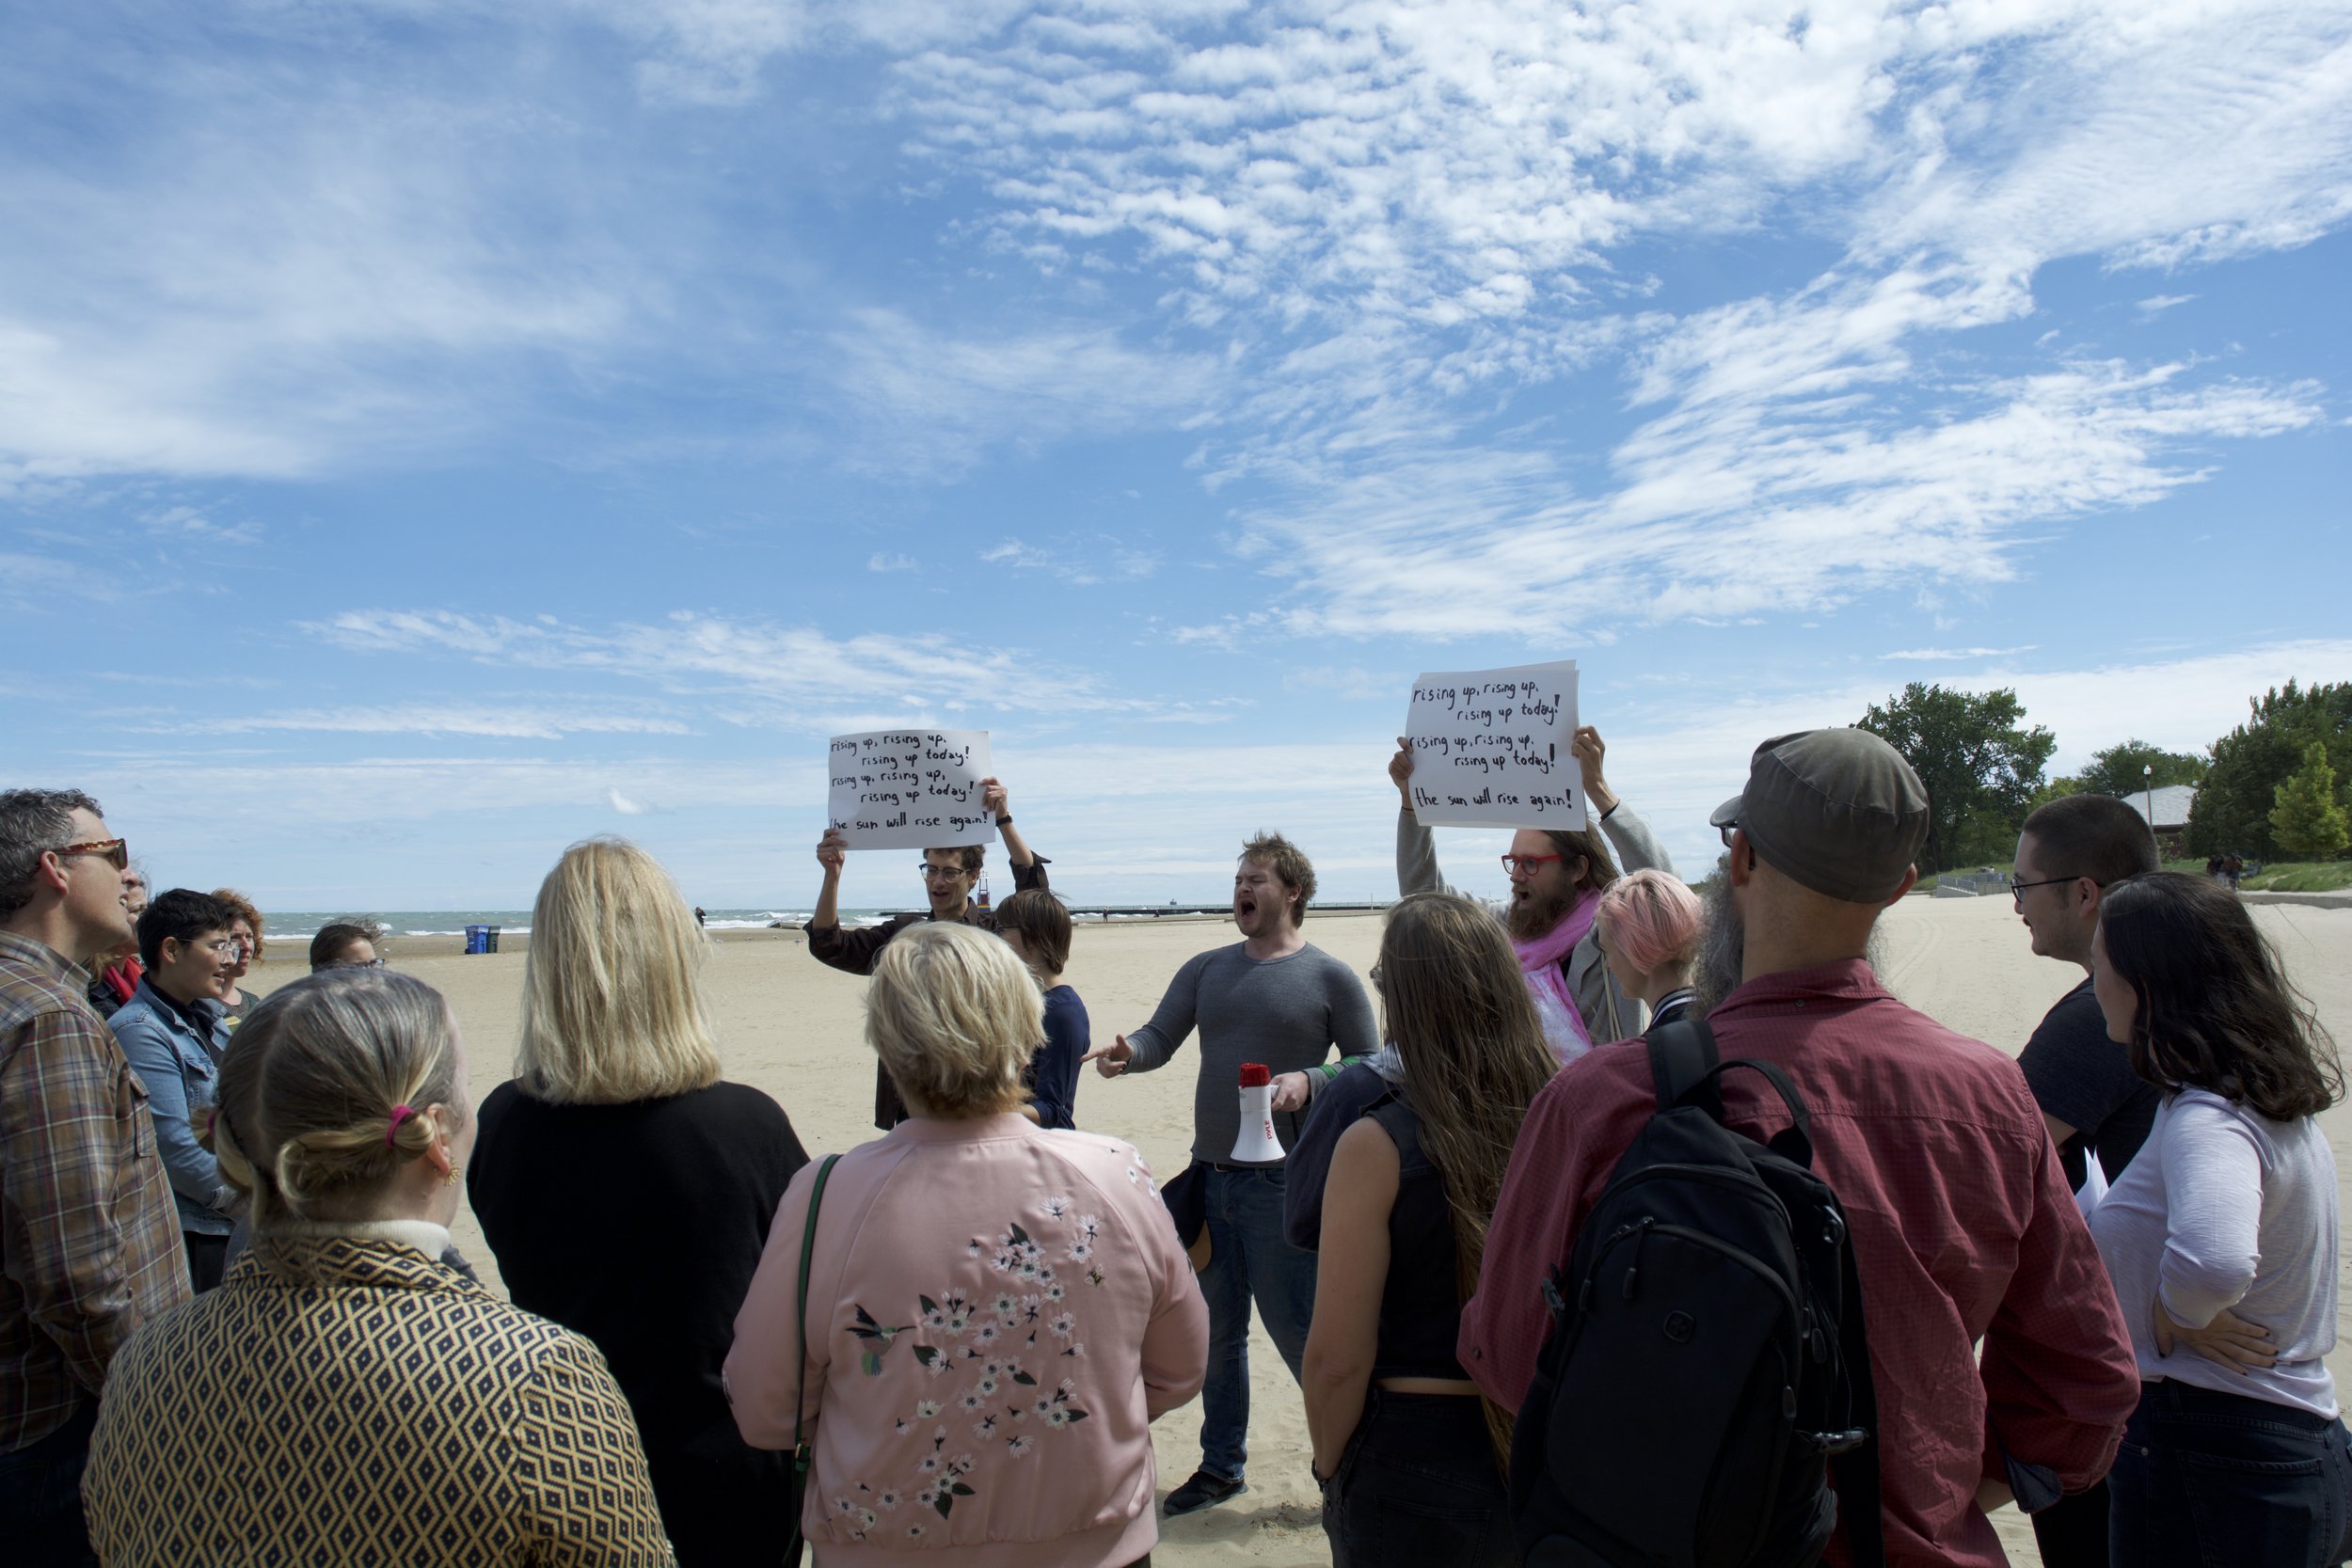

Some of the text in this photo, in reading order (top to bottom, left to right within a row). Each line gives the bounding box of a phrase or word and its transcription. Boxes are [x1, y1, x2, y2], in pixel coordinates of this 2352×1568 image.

[1412, 688, 1455, 710] rising
[1484, 683, 1516, 699] rising
[1457, 694, 1560, 727] rising up today!
[831, 740, 857, 756] rising
[883, 735, 920, 748] rising
[1409, 736, 1448, 755] rising
[1474, 734, 1513, 751] rising
[862, 746, 969, 769] rising up today!
[1454, 743, 1555, 774] rising up today!
[832, 776, 856, 789] rising
[881, 772, 918, 785] rising
[860, 782, 974, 805] rising up today!
[1415, 786, 1572, 812] the sun will rise again!
[856, 818, 878, 830] sun
[886, 812, 907, 827] will
[915, 816, 941, 826] rise
[950, 811, 988, 832] again!
